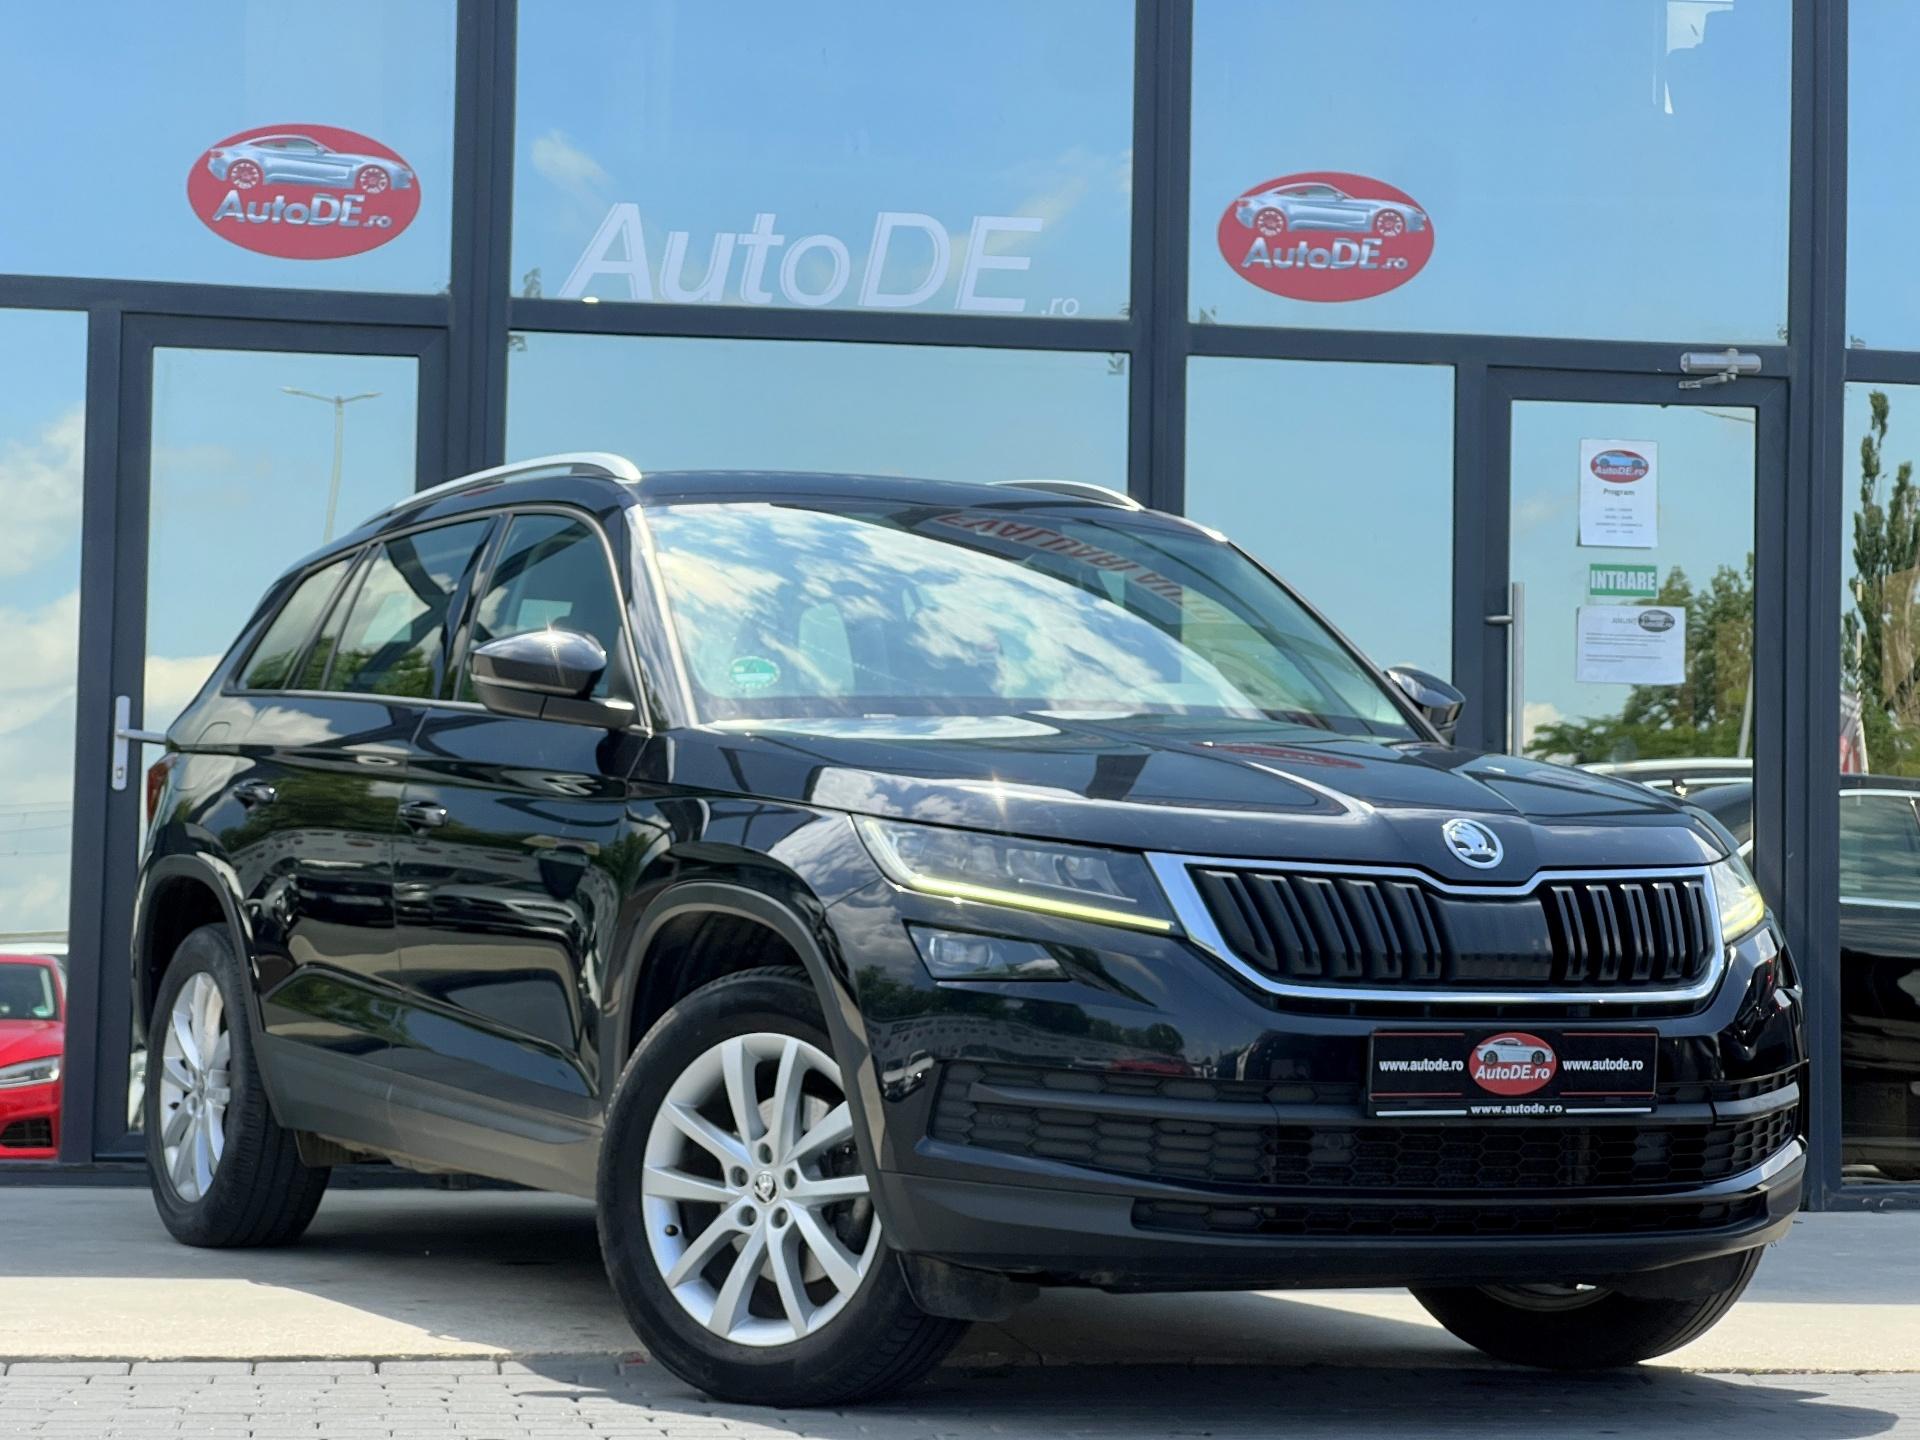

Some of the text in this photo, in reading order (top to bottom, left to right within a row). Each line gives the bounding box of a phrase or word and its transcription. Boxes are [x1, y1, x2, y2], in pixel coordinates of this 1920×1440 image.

[1603, 488, 1635, 497] Program
[1591, 570, 1656, 590] INTRARE
[1379, 1056, 1644, 1081] www.autode.ro AutoDE.ro www.autode.ro
[1470, 1103, 1563, 1114] www.autode.ro
